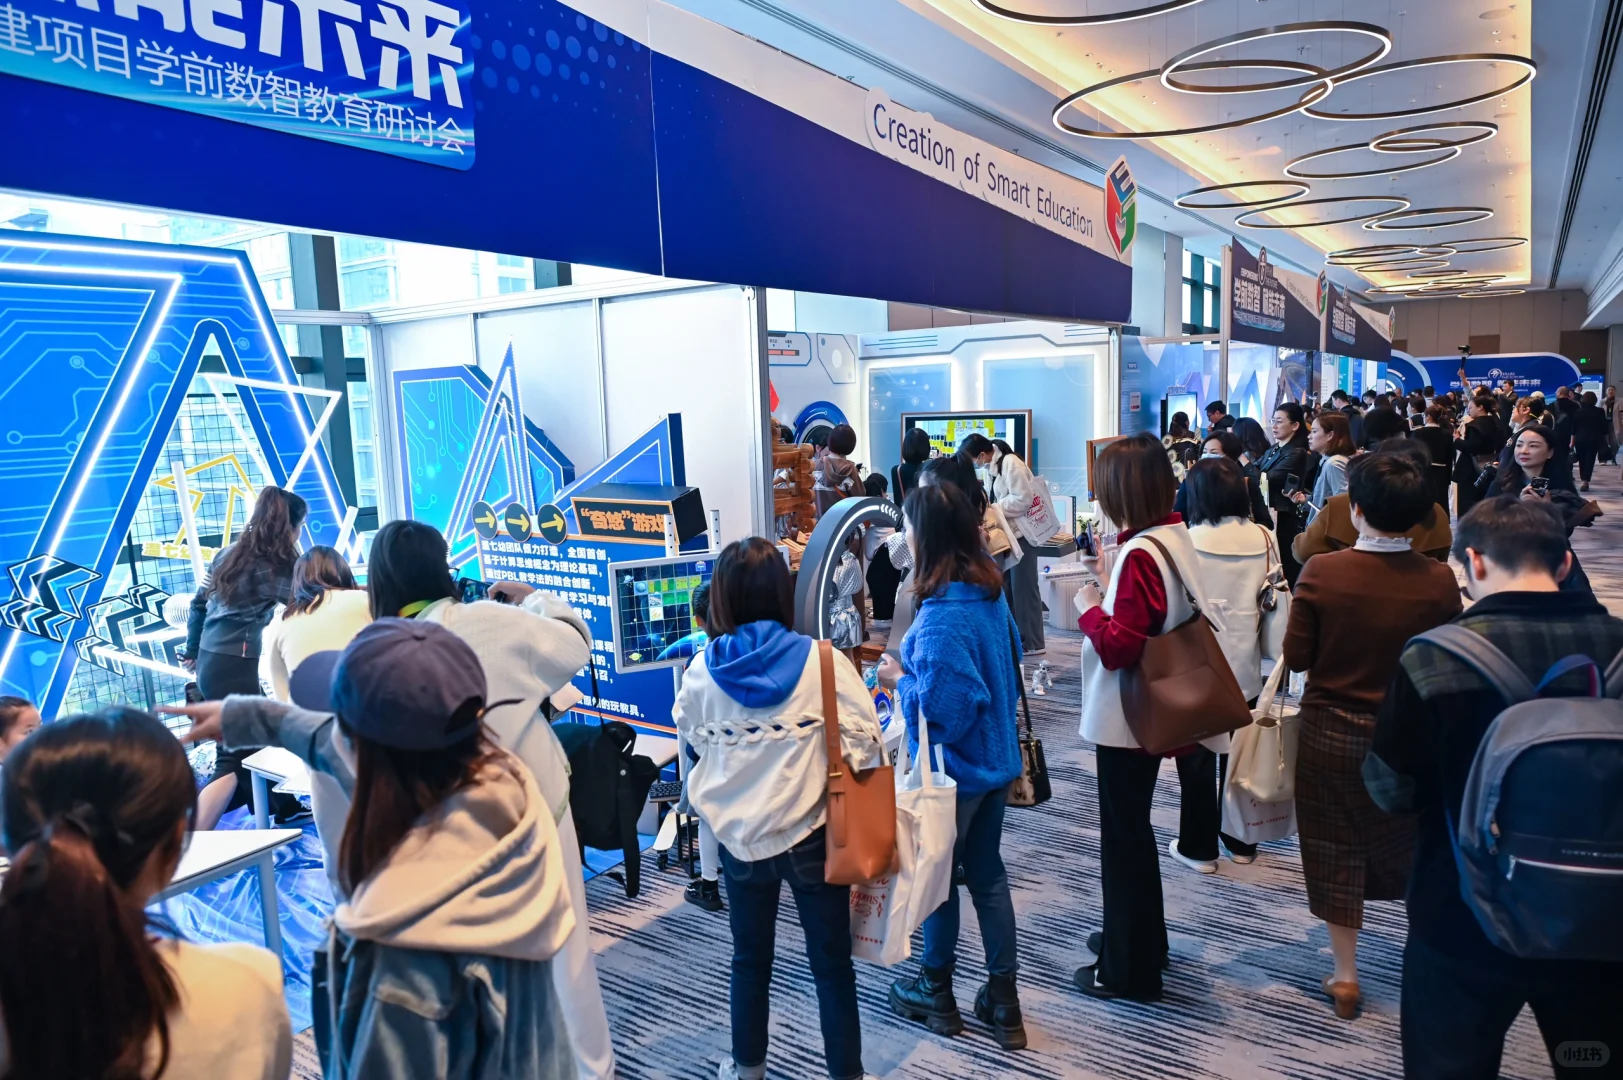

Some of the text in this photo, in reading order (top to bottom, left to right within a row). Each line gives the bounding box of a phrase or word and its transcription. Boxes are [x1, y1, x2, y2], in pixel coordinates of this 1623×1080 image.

[873, 104, 1093, 238] Creation of Smart Education
